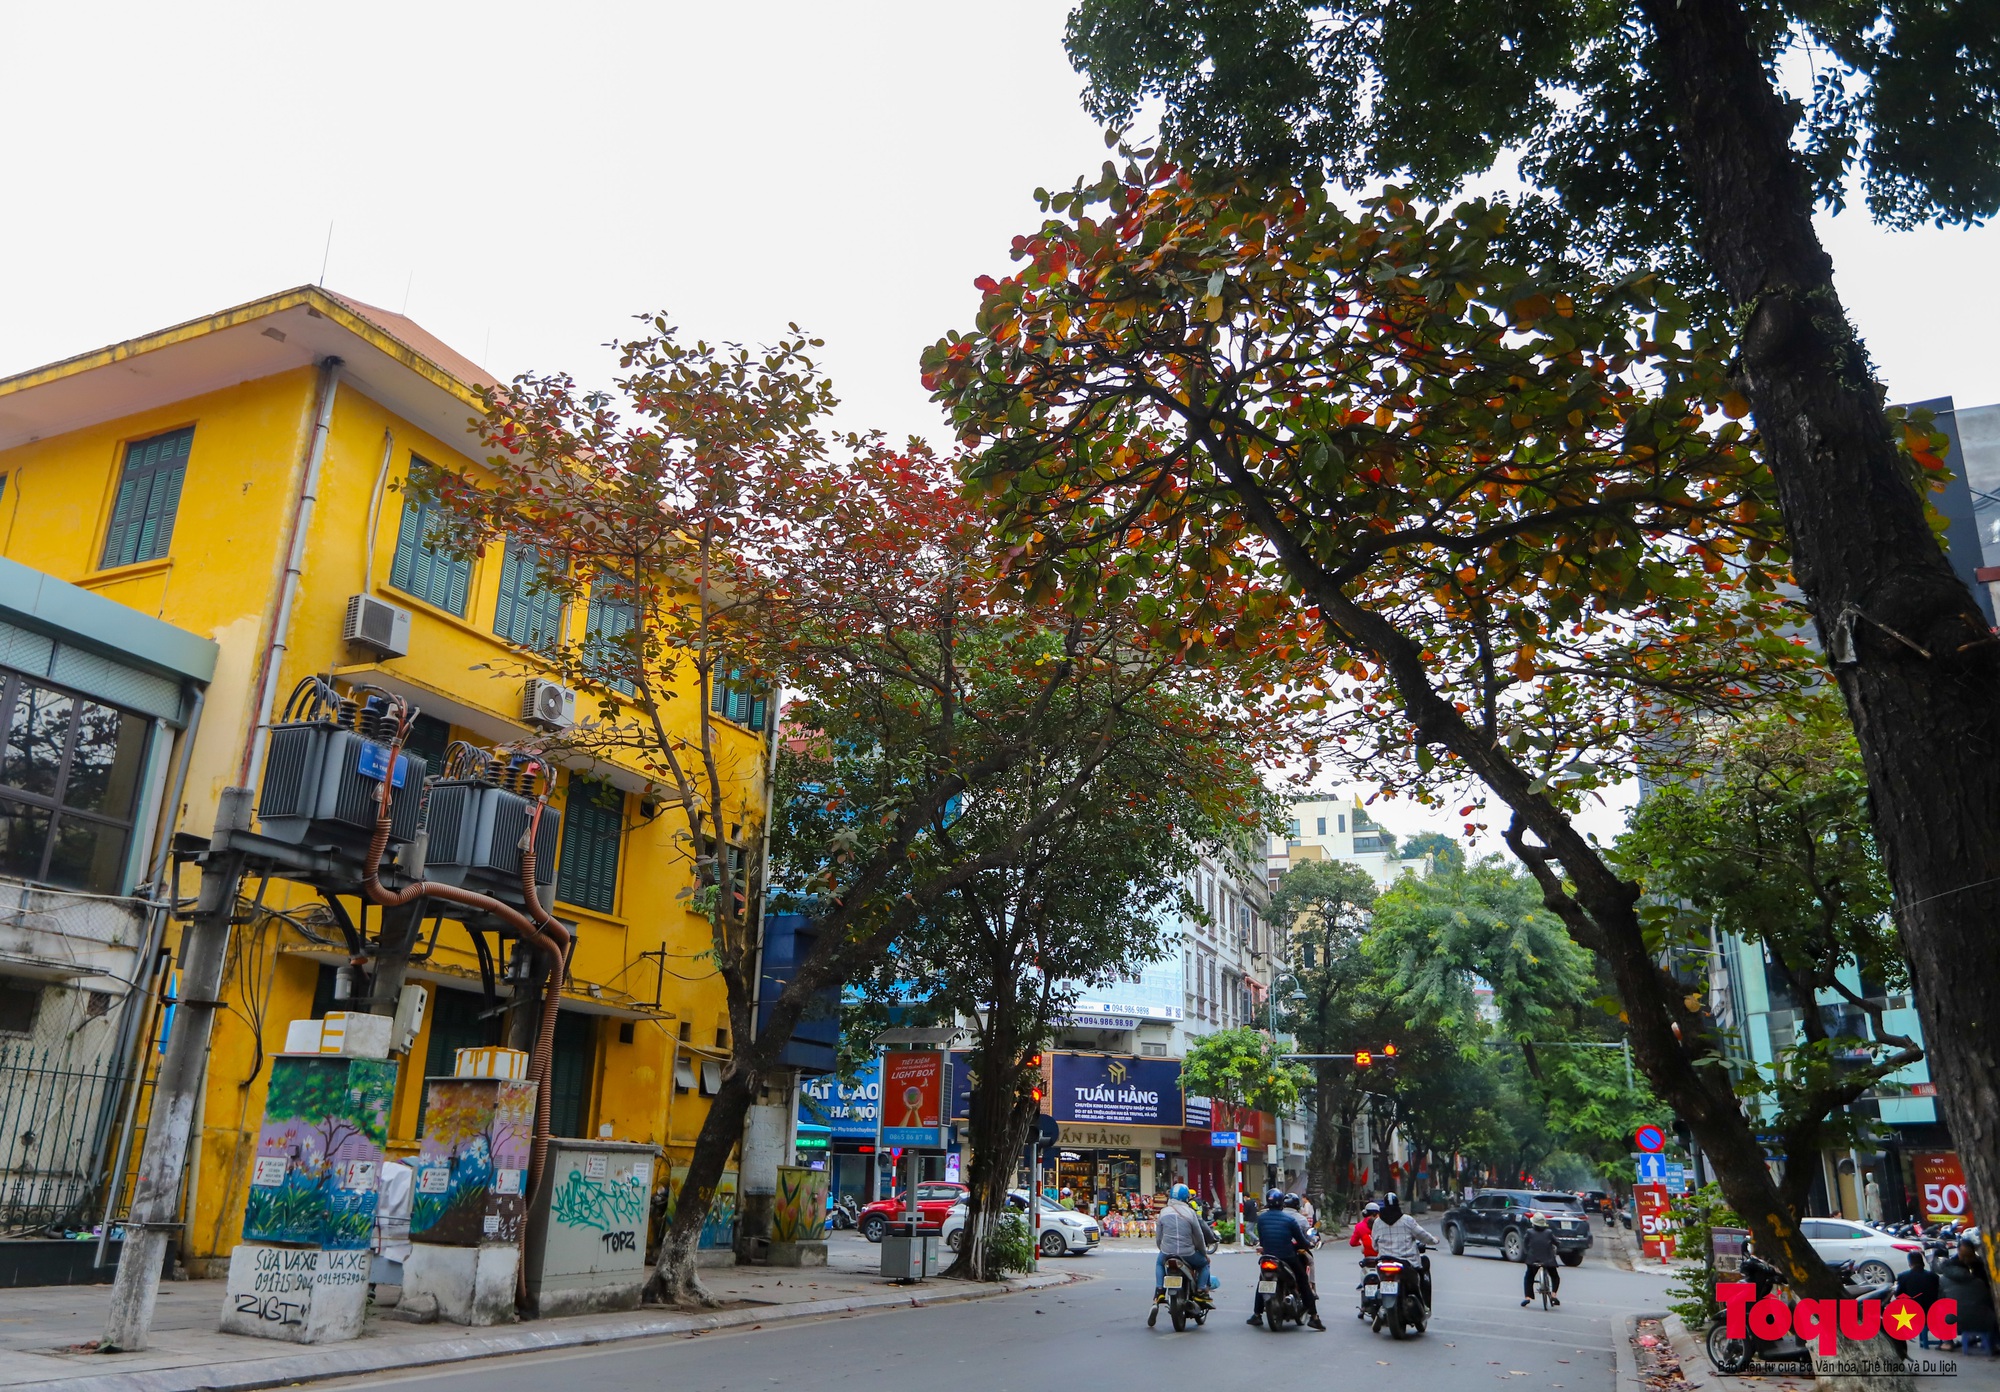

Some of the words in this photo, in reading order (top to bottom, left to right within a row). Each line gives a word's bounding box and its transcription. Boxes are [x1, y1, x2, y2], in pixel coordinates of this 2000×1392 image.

[1112, 1004, 1150, 1015] 094.986.9898
[1084, 1018, 1134, 1028] 094.986.98.98
[892, 1070, 916, 1079] LIGHT
[916, 1069, 935, 1078] BOX
[838, 1082, 879, 1100] CAO
[1074, 1084, 1114, 1102] TUẤN
[1118, 1085, 1159, 1104] HẰNG
[830, 1103, 850, 1118] HÀ
[1060, 1127, 1082, 1144] ẤN
[1882, 1131, 1903, 1141] EM
[602, 1231, 636, 1254] TOPZ
